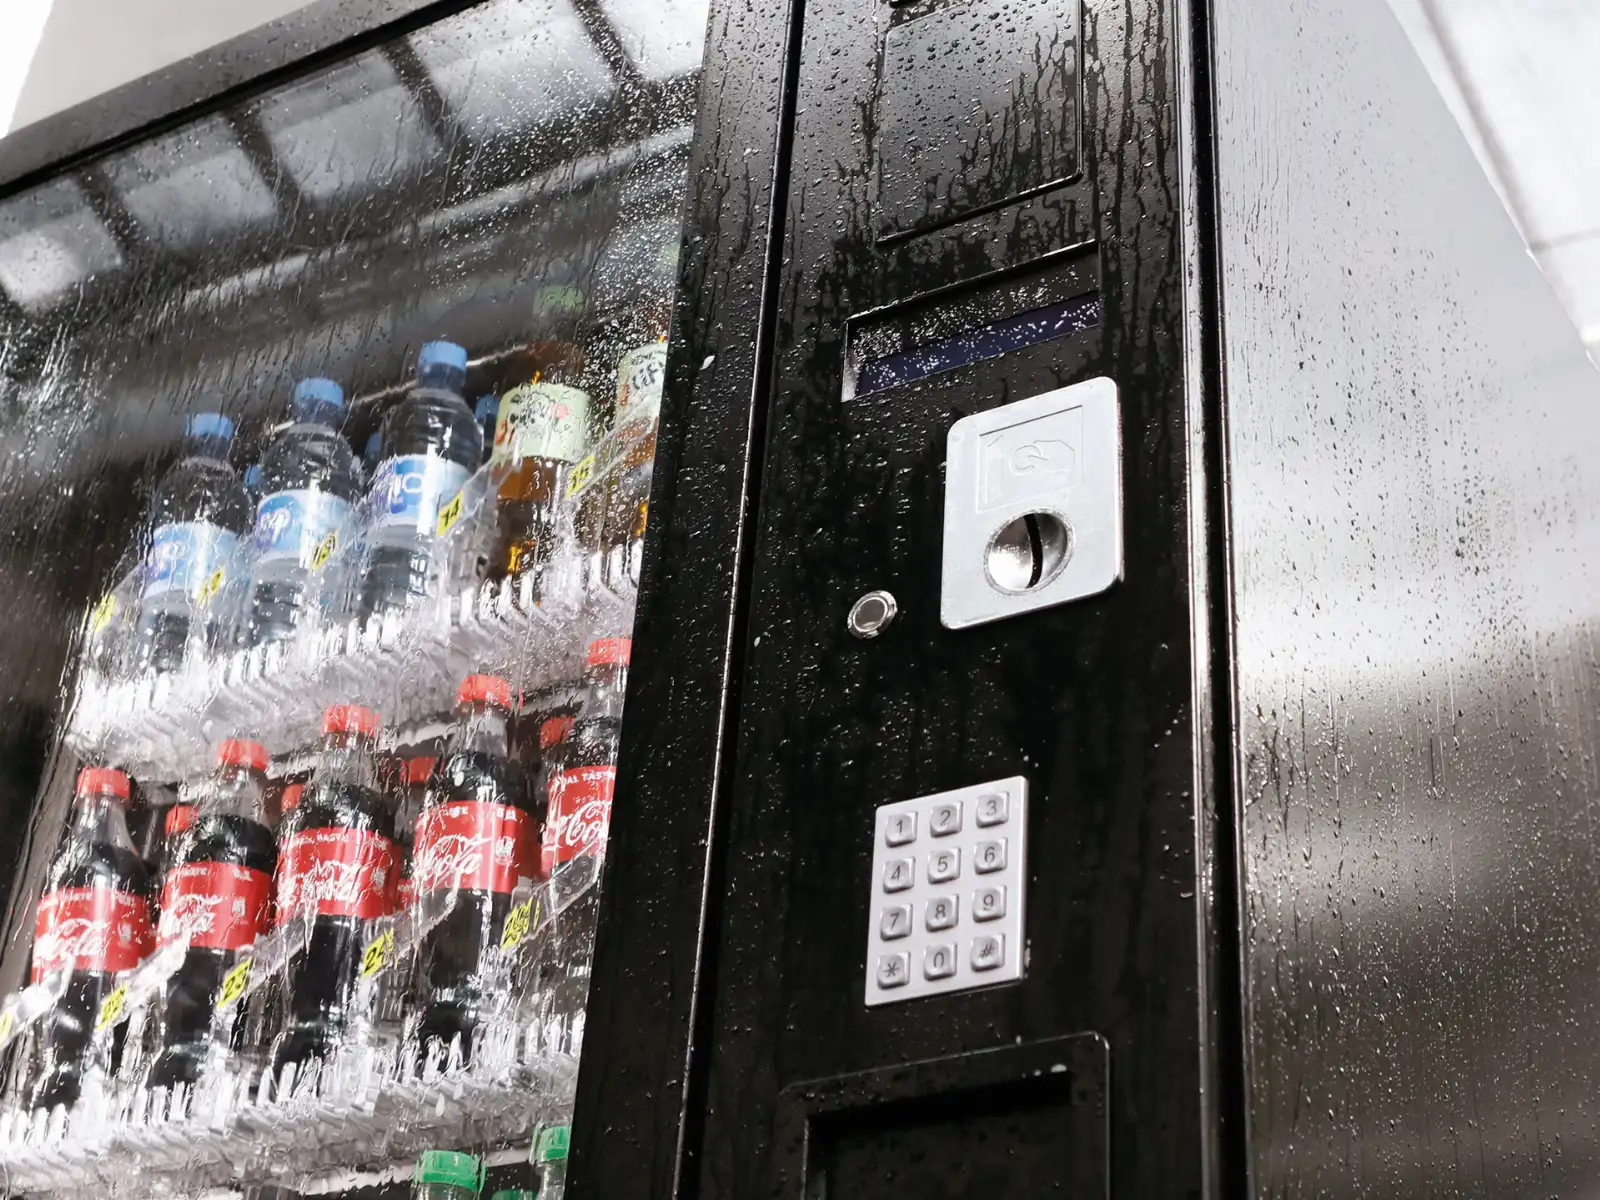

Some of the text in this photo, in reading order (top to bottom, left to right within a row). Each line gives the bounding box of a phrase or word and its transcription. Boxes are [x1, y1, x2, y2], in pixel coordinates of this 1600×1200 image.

[895, 799, 998, 835] 1 2 3
[890, 846, 996, 882] 4 5 6
[889, 893, 995, 930] 7 8 9
[933, 951, 945, 969] 0
